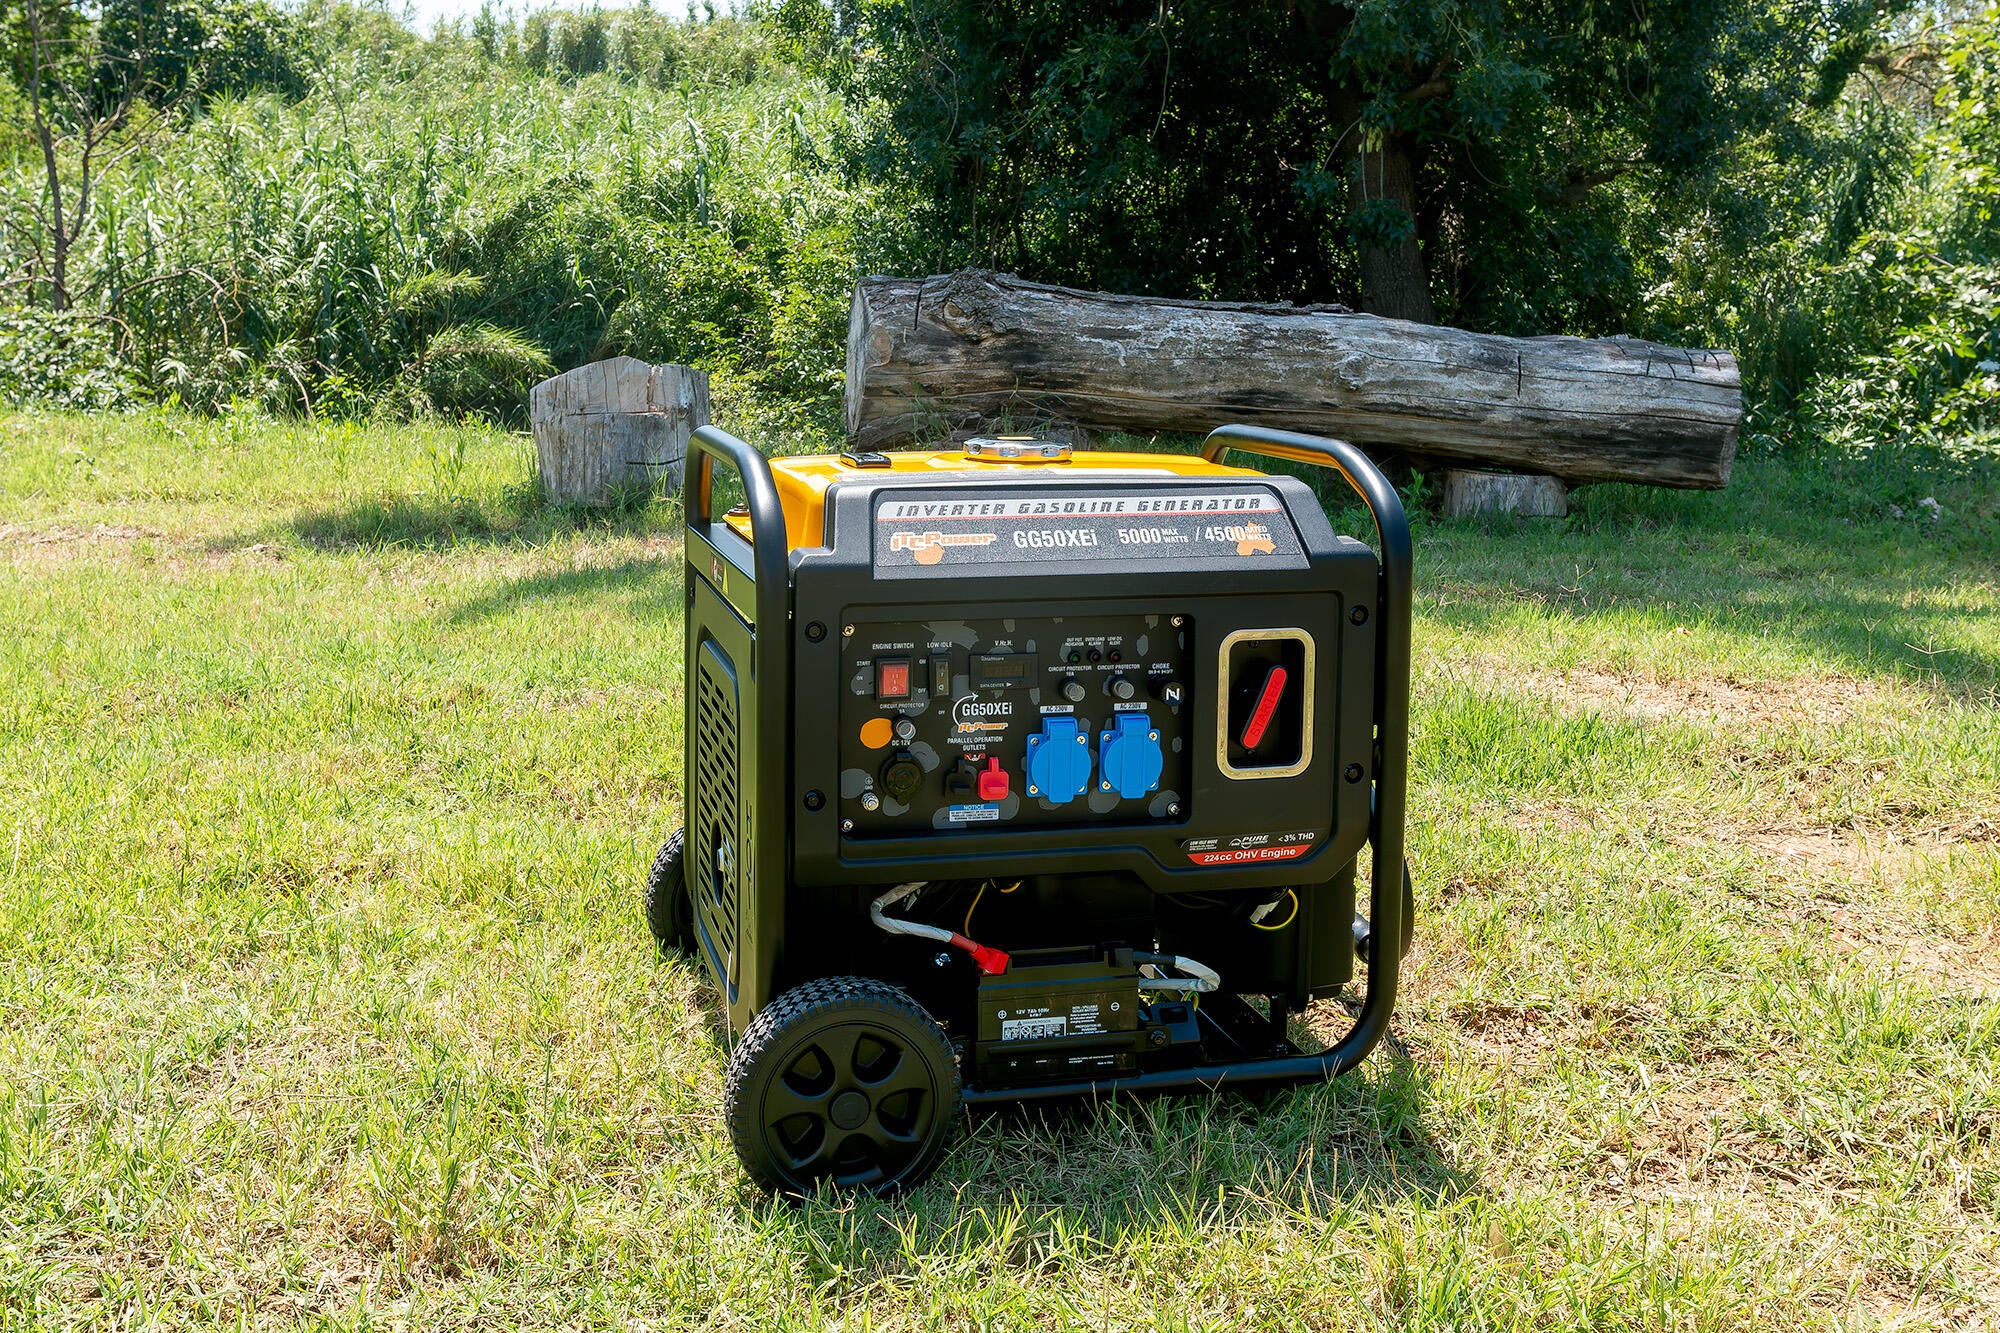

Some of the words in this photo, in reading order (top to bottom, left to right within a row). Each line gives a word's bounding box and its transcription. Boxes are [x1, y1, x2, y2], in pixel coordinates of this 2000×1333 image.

[897, 503, 1005, 516] INVERTER
[1018, 500, 1125, 514] GASOLINE
[1137, 498, 1261, 512] GENERATOR
[1013, 528, 1098, 548] GG50XEi
[1118, 527, 1161, 544] 5000
[1164, 534, 1188, 543] WATTS
[1204, 526, 1245, 542] 4500
[1246, 533, 1271, 541] WATTS
[962, 702, 1012, 716] GG50XEi
[1251, 678, 1281, 737] STARTER
[1204, 854, 1232, 862] 224cc
[1235, 850, 1259, 860] OHV
[1261, 848, 1296, 858] Engine
